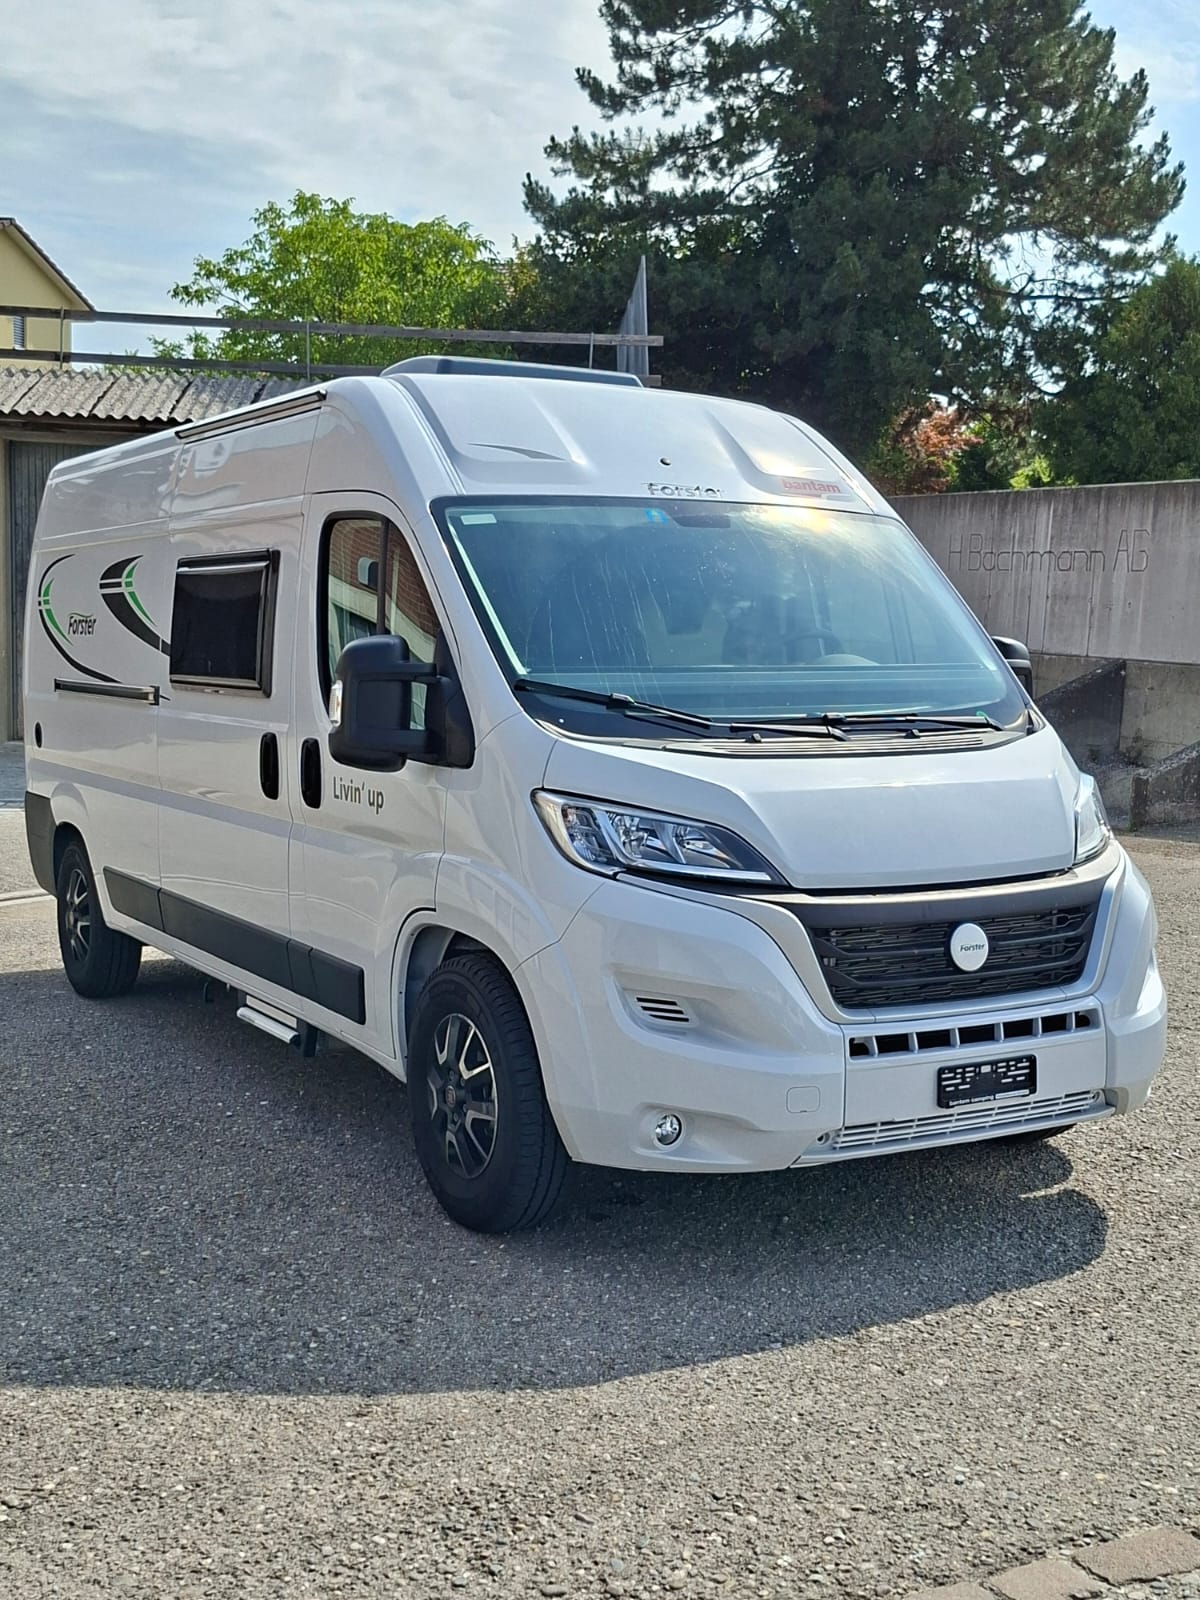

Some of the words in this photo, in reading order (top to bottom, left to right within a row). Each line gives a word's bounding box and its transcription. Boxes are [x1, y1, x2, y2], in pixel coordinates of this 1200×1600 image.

[782, 480, 841, 493] bantam
[1113, 529, 1150, 573] AG
[68, 615, 97, 636] Forster
[368, 789, 384, 815] up
[960, 944, 985, 952] Forster
